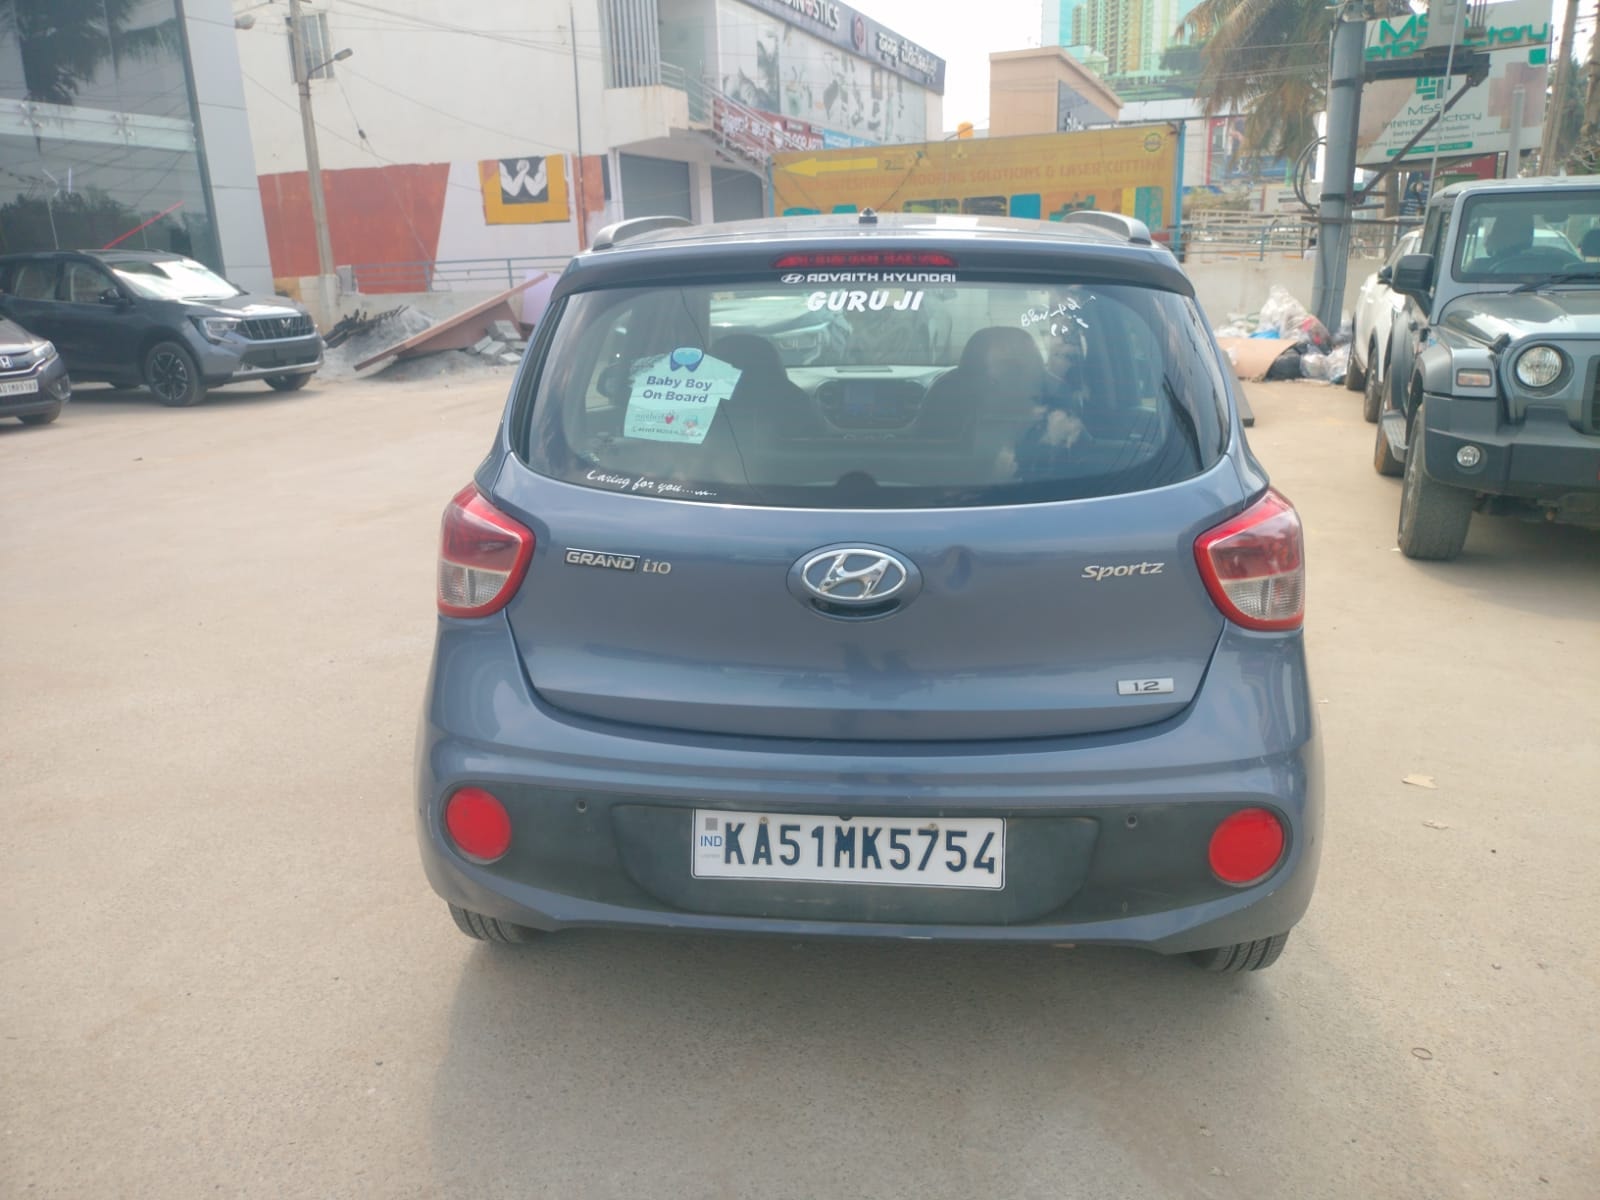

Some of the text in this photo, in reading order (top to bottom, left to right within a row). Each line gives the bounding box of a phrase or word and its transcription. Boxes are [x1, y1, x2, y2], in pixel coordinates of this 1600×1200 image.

[807, 273, 956, 283] ADVAITH HYUNDAI
[806, 290, 924, 312] GURU JI
[646, 376, 712, 392] Baby Boy
[643, 390, 708, 403] On Board
[586, 470, 630, 489] Caring
[632, 476, 654, 491] for
[566, 551, 635, 570] GRAND
[1081, 562, 1165, 581] Sportz
[700, 822, 996, 874] IND KA51MK5754
